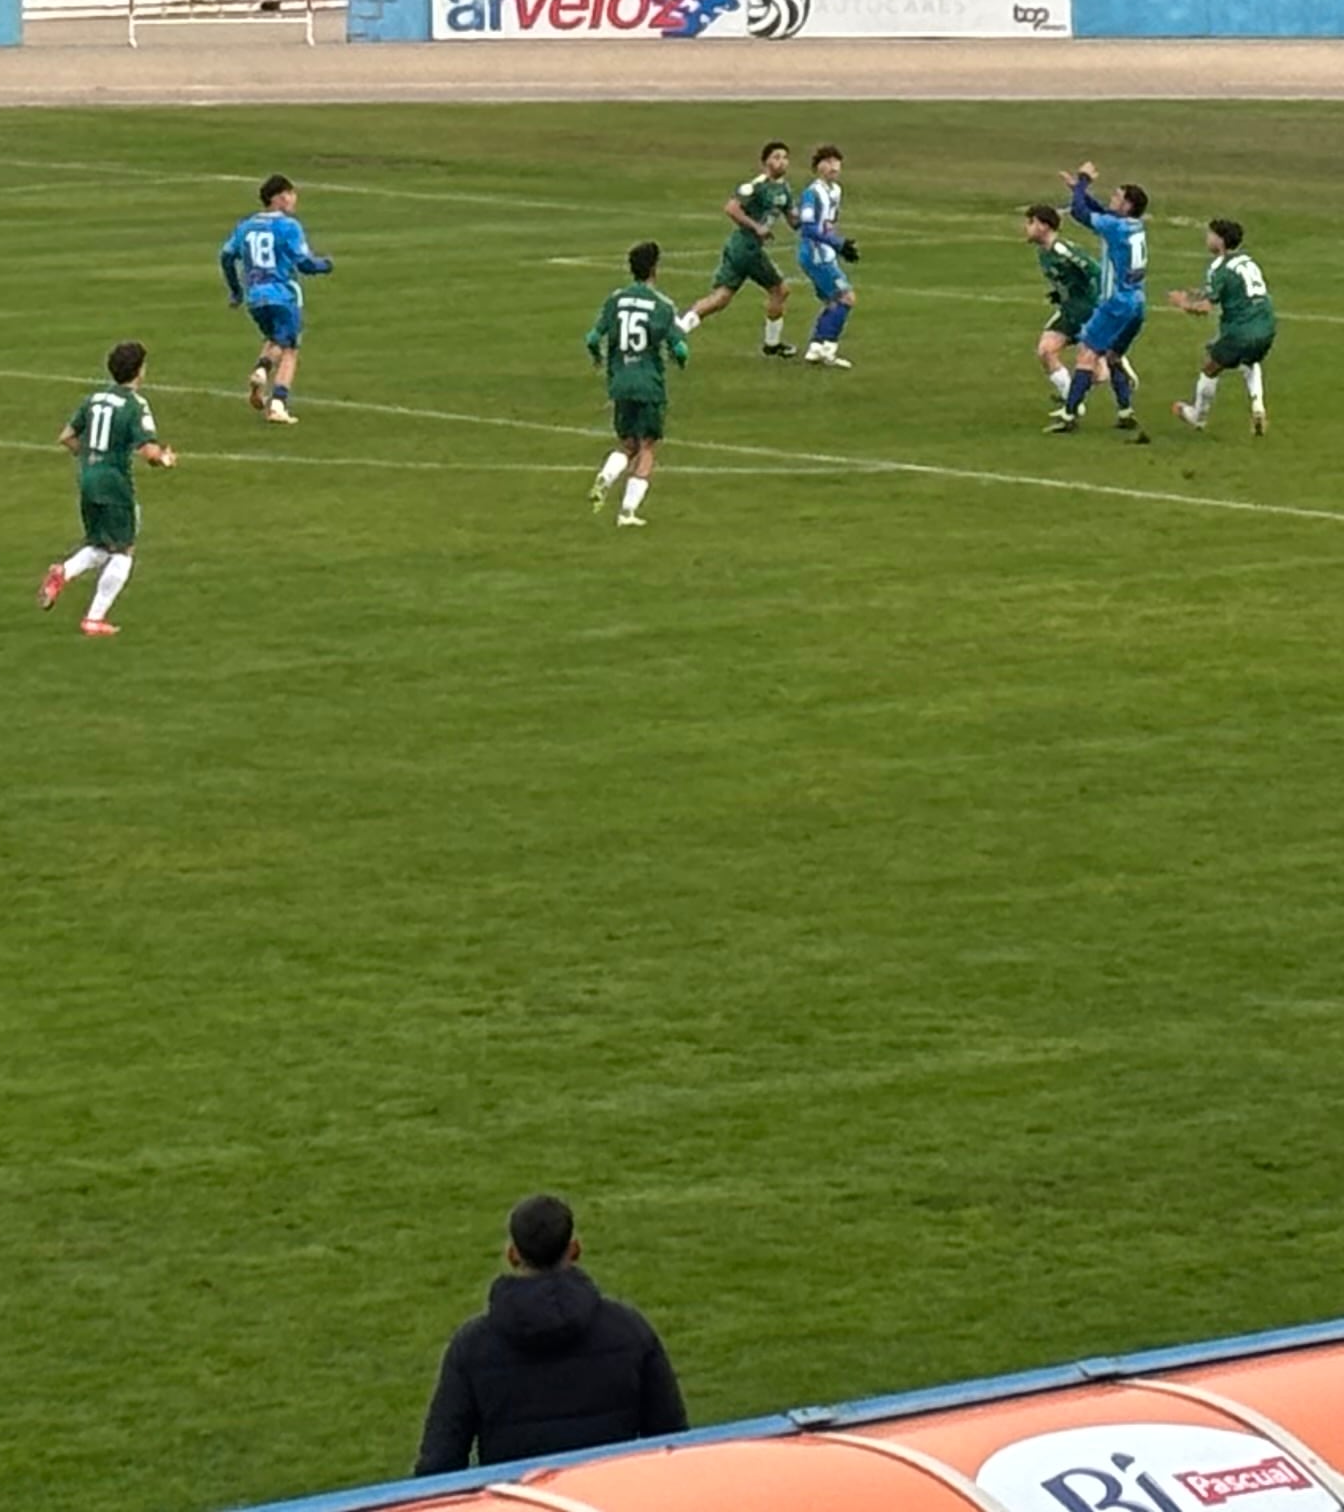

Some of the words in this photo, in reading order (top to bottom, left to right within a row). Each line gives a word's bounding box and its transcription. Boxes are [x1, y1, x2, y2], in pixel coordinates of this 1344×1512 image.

[245, 231, 277, 268] 18
[617, 310, 649, 352] 15
[89, 403, 114, 451] 11
[1185, 1460, 1300, 1499] Pascual
